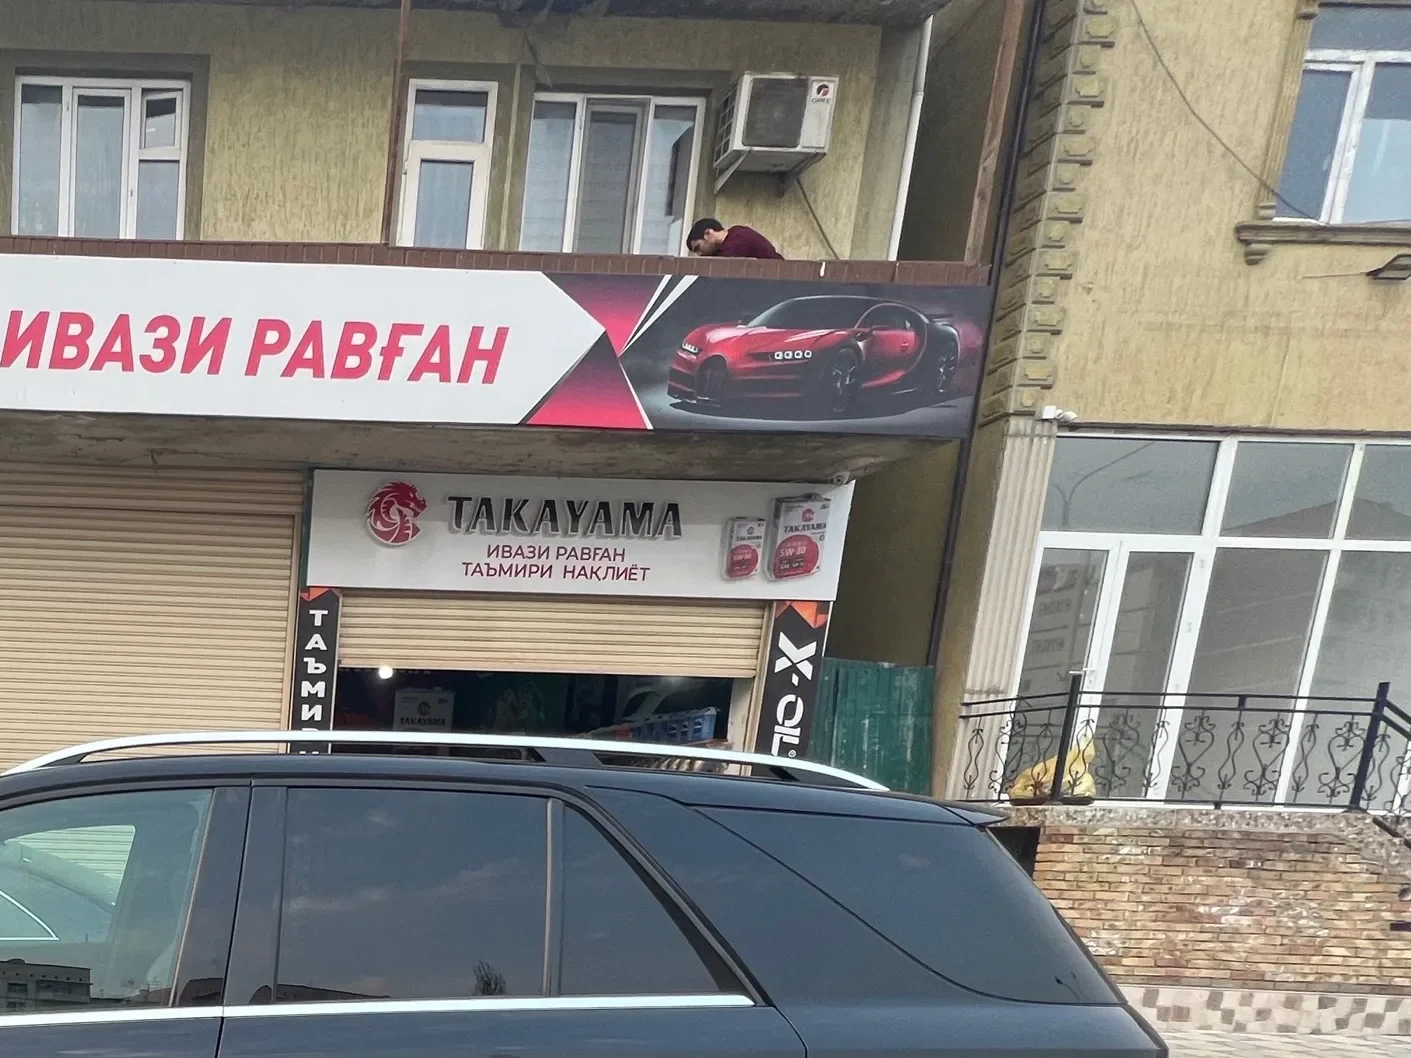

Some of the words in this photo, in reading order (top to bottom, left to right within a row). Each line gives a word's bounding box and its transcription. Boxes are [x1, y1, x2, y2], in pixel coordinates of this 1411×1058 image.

[0, 310, 232, 375] ИВАЗИ
[244, 318, 510, 385] РАВҒАН
[447, 496, 684, 538] TAKAYAMA
[462, 561, 553, 579] ТАЪМИРИ
[562, 564, 651, 582] НАҚЛИЁТ
[487, 544, 550, 561] ИВАЗИ
[556, 547, 626, 563] РАВҒАН
[299, 609, 329, 754] ТАЪМИ
